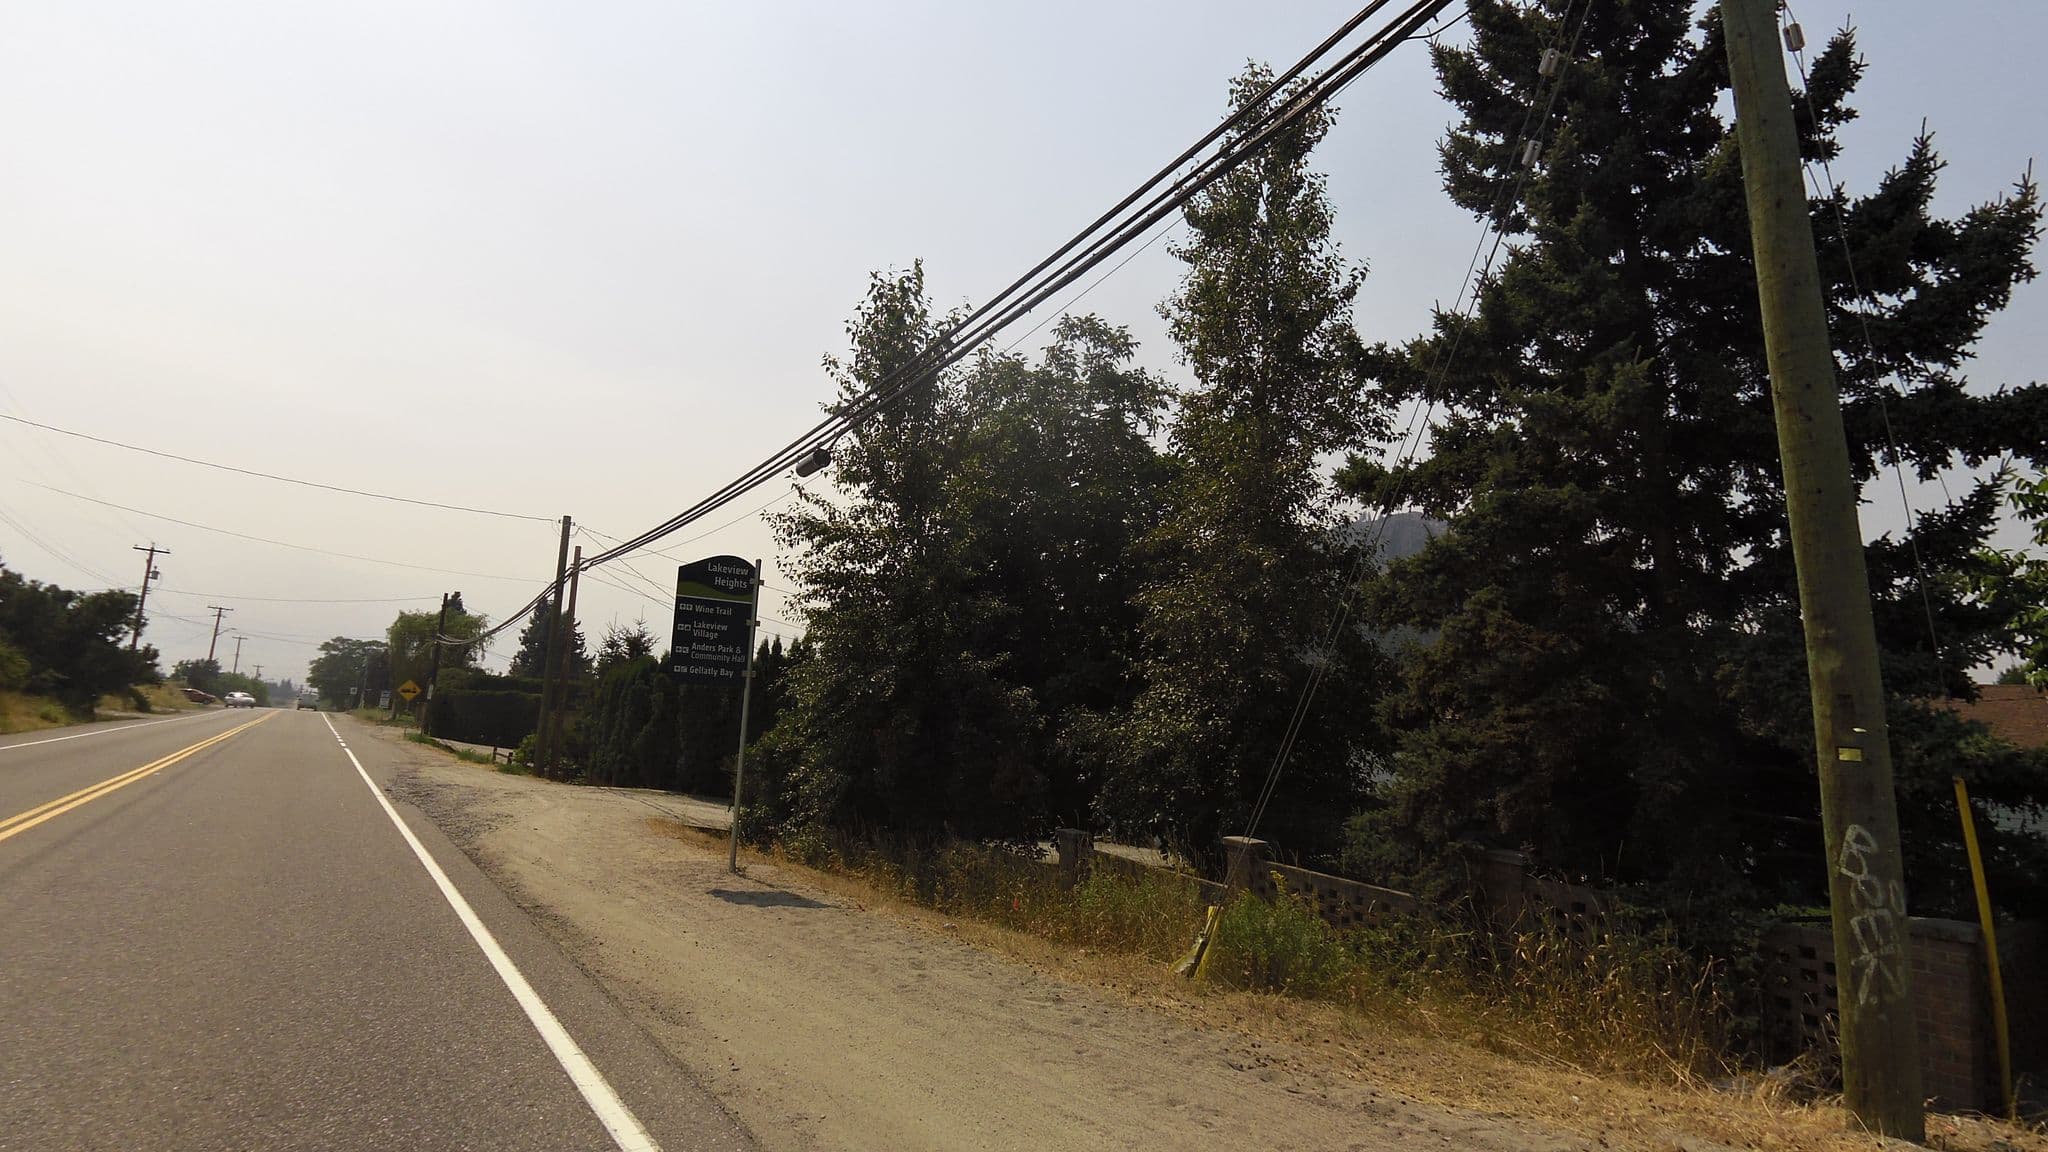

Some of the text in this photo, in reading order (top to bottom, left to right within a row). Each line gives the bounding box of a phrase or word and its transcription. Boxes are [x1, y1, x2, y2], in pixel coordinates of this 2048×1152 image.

[708, 562, 749, 575] Lakeview
[714, 577, 747, 589] Heights
[695, 604, 732, 616] Wine Trail
[693, 621, 728, 631] Lakeview
[693, 629, 719, 640] Village
[691, 643, 741, 654] Anders Park &
[691, 651, 745, 663] Community Hall
[689, 666, 734, 678] Gellatly Bay
